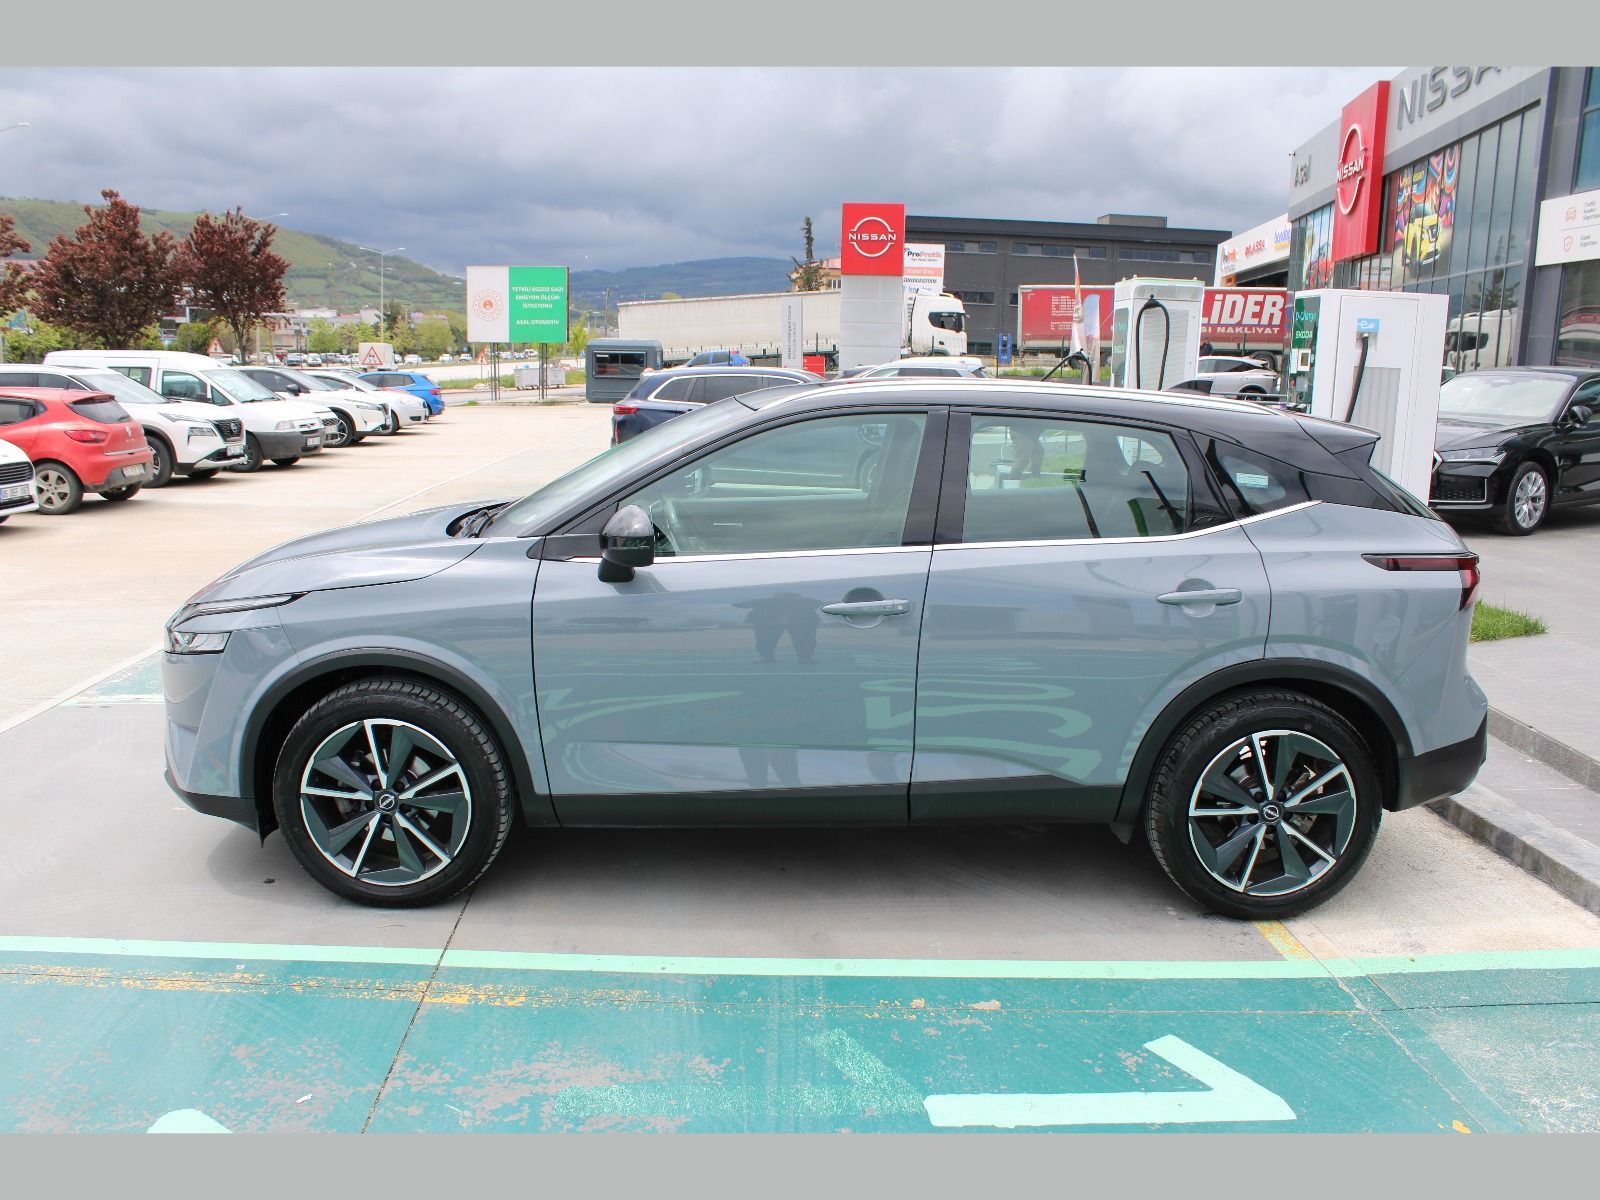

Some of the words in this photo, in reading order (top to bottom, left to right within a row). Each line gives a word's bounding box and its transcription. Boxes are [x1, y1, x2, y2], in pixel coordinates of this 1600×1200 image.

[1397, 66, 1501, 130] NISS
[1336, 154, 1365, 183] NISSAN
[848, 233, 897, 241] NISSAN
